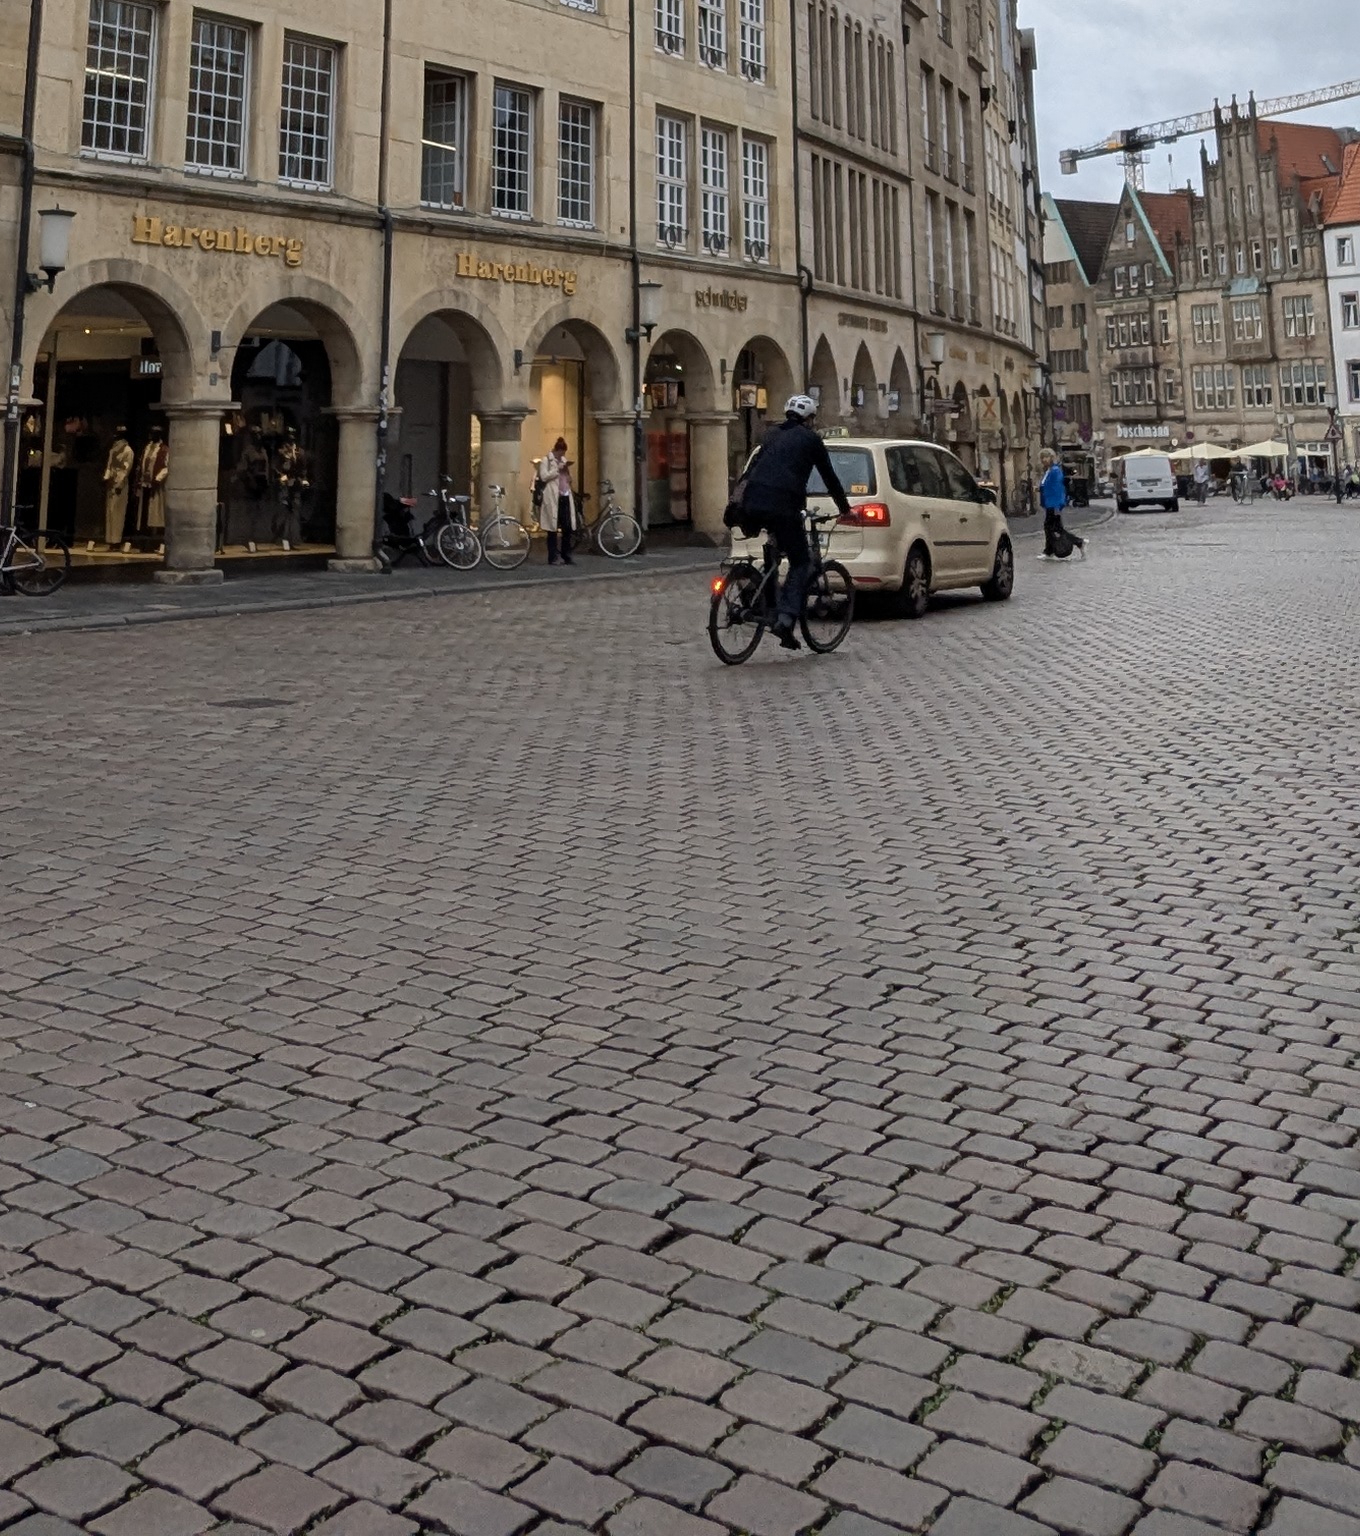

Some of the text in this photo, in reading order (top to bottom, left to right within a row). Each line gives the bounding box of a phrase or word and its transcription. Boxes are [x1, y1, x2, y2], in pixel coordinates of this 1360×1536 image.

[132, 214, 304, 266] Harenberg
[456, 252, 578, 296] Harenberg
[1116, 424, 1170, 438] buschmann
